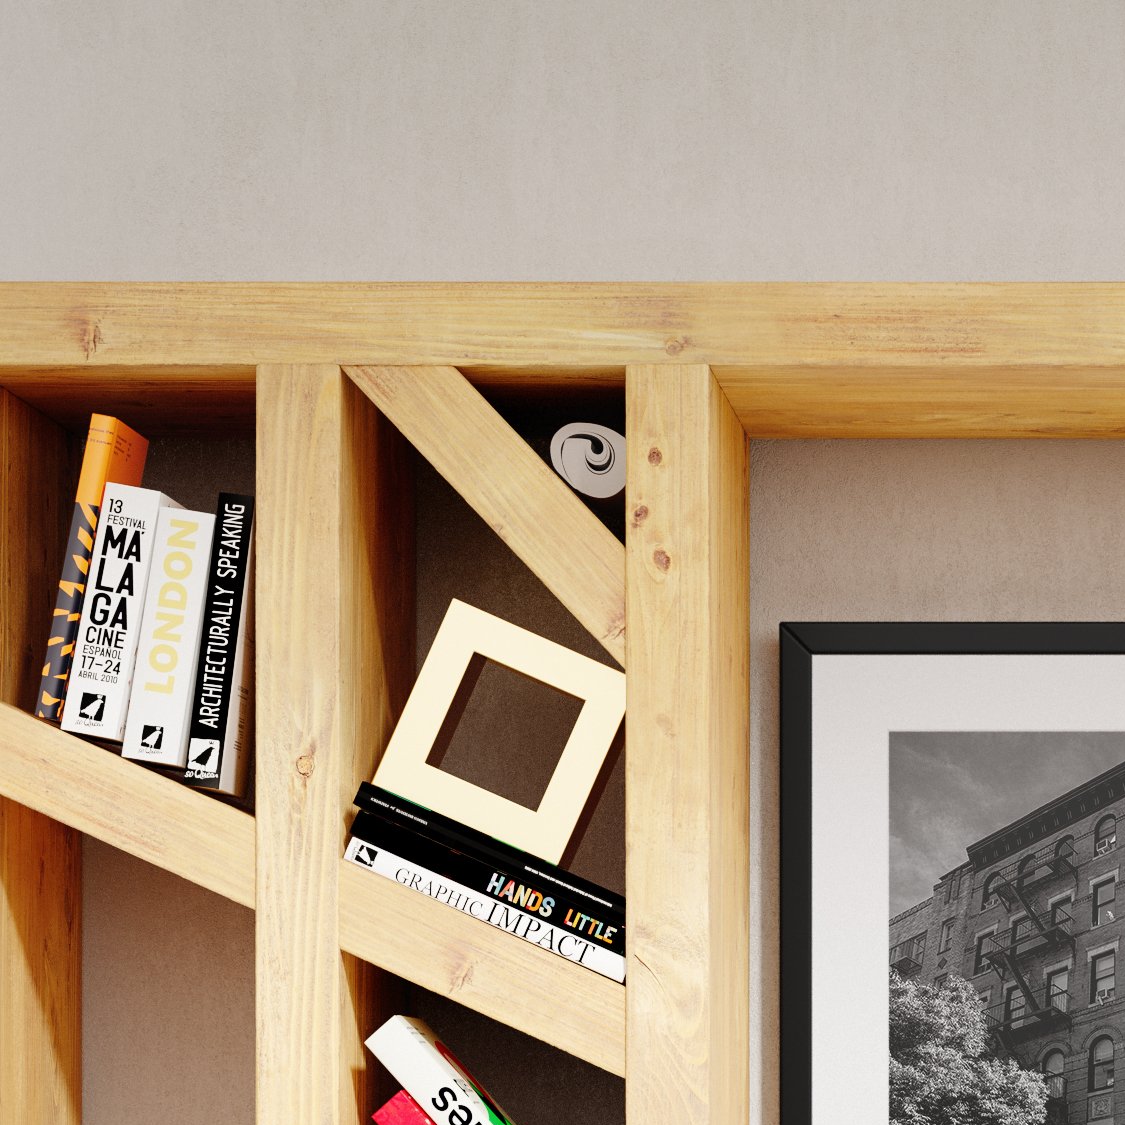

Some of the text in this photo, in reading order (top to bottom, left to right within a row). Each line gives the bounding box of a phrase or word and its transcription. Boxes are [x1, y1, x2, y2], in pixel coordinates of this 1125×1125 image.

[107, 514, 146, 530] FESTIVAL
[109, 499, 123, 513] 13
[95, 558, 134, 596] LA
[90, 593, 128, 631] GA
[144, 519, 199, 695] LONDON
[198, 503, 245, 729] ARCHITECTURALLY SPEAKING
[85, 626, 126, 649] CINE
[79, 671, 118, 684] ABRIL 2010
[395, 868, 483, 917] GRAPHIC
[485, 901, 596, 964] IMPACT
[486, 872, 556, 918] HANDS
[563, 908, 618, 944] LITTLE
